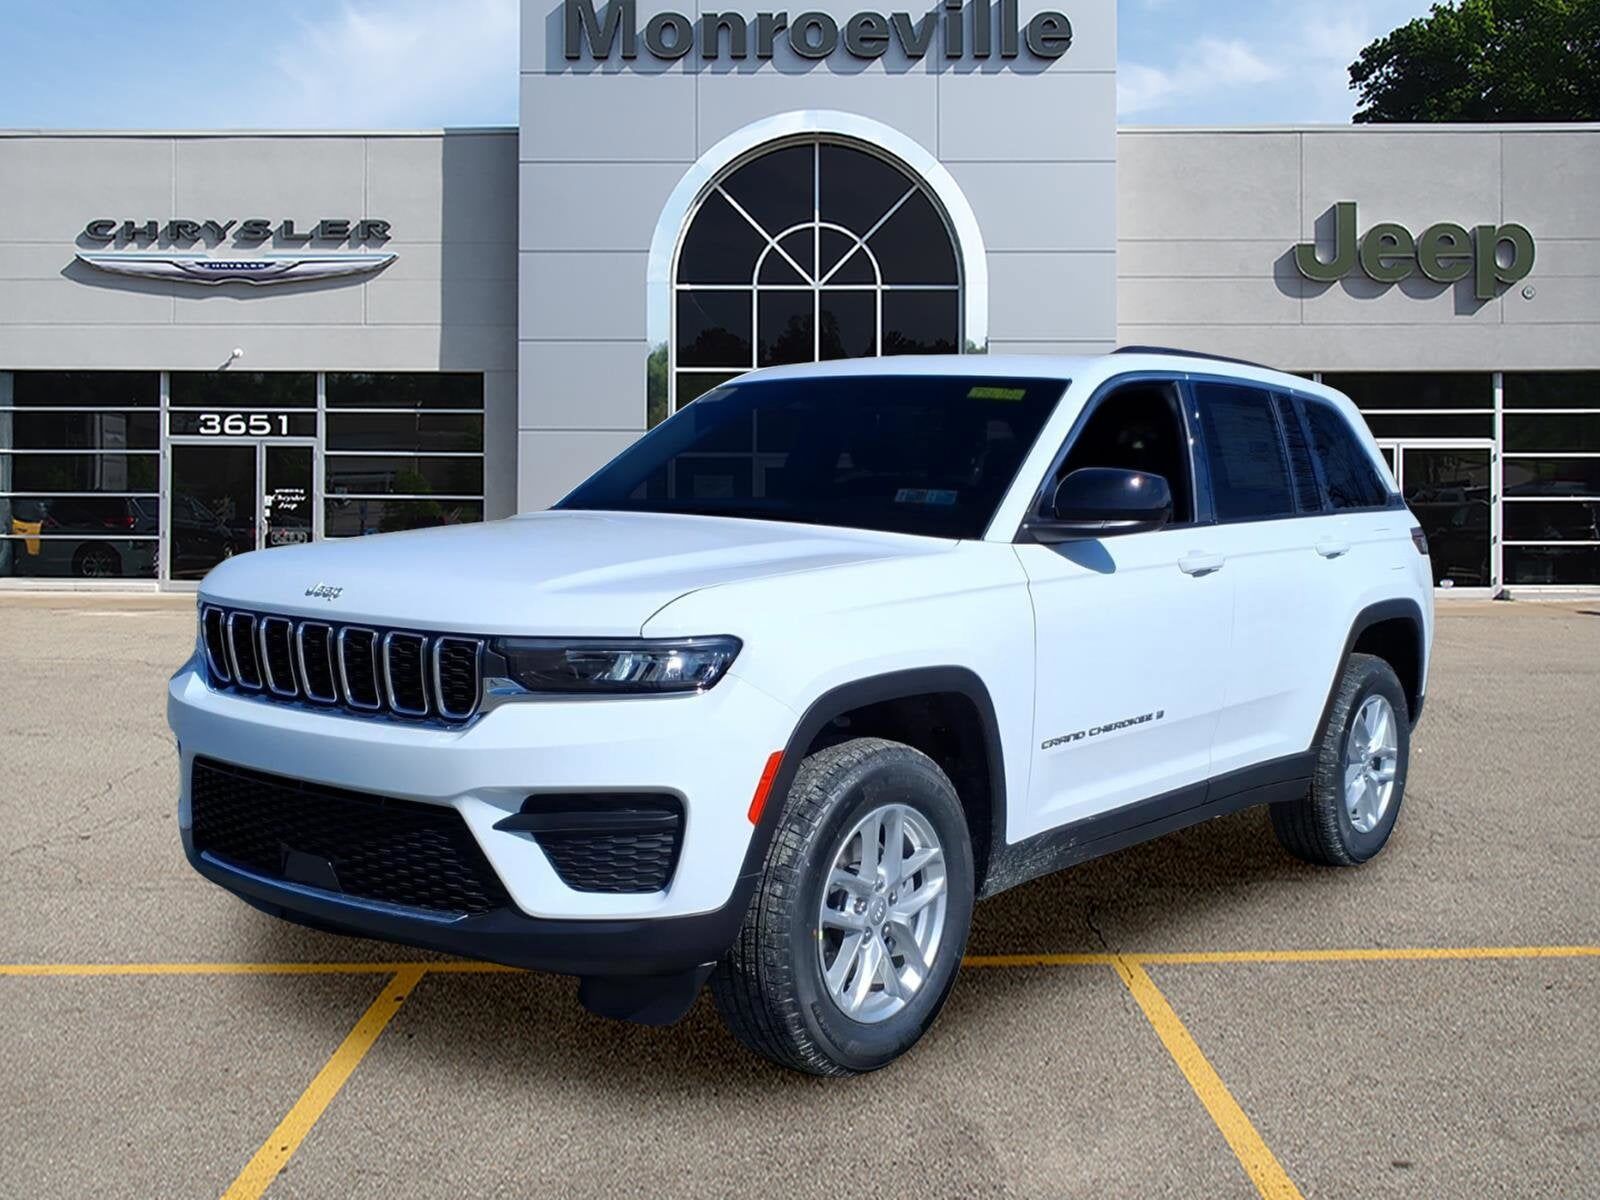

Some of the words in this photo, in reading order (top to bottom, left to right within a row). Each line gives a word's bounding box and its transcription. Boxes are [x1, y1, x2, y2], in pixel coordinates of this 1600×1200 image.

[563, 0, 1074, 60] Monroeville
[85, 219, 392, 242] CHRYSLER
[1294, 201, 1536, 299] Jeep
[199, 413, 289, 436] 3651
[304, 583, 344, 602] Jeep
[1041, 731, 1085, 750] GRAND
[1089, 713, 1153, 736] CHEROKEE
